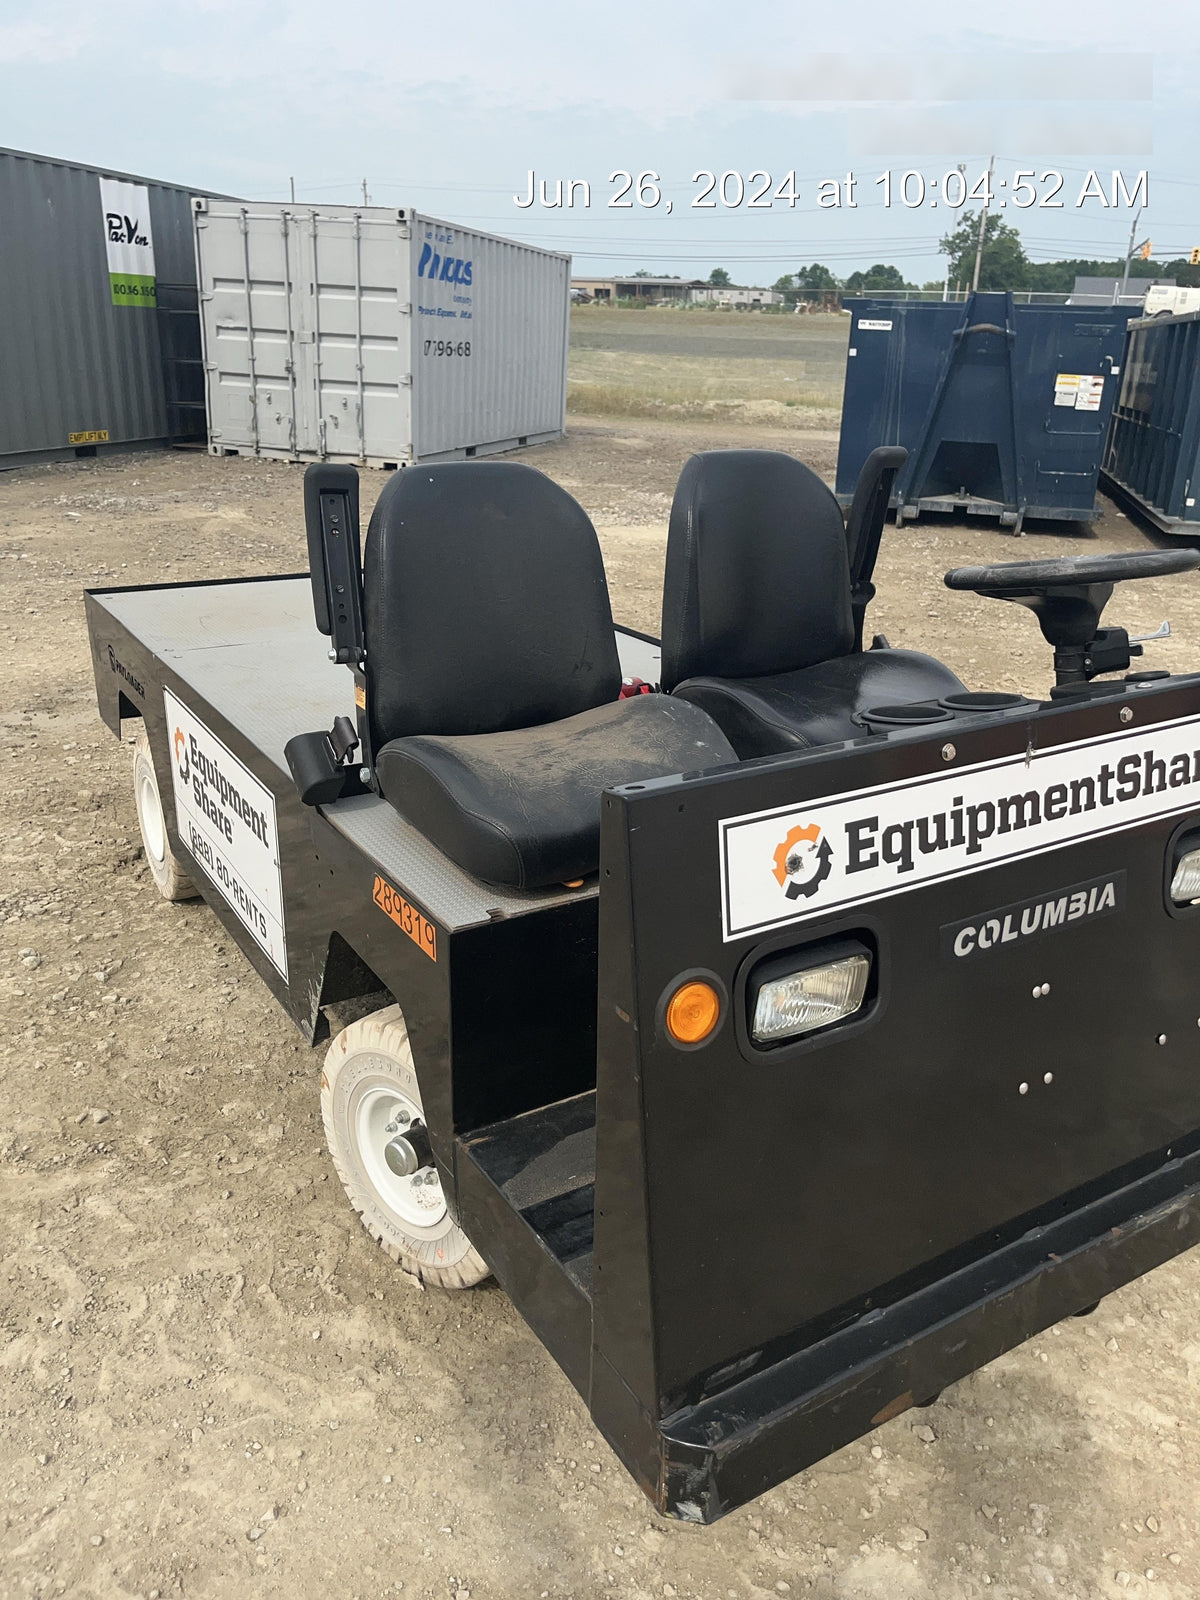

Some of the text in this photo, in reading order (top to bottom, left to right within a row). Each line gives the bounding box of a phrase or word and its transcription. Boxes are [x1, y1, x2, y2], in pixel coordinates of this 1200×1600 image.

[188, 732, 270, 849] Equipment
[192, 773, 233, 845] Share
[188, 820, 268, 939] (888) 80-RENTS
[374, 874, 436, 960] 289319
[953, 881, 1116, 958] COLUMBIA
